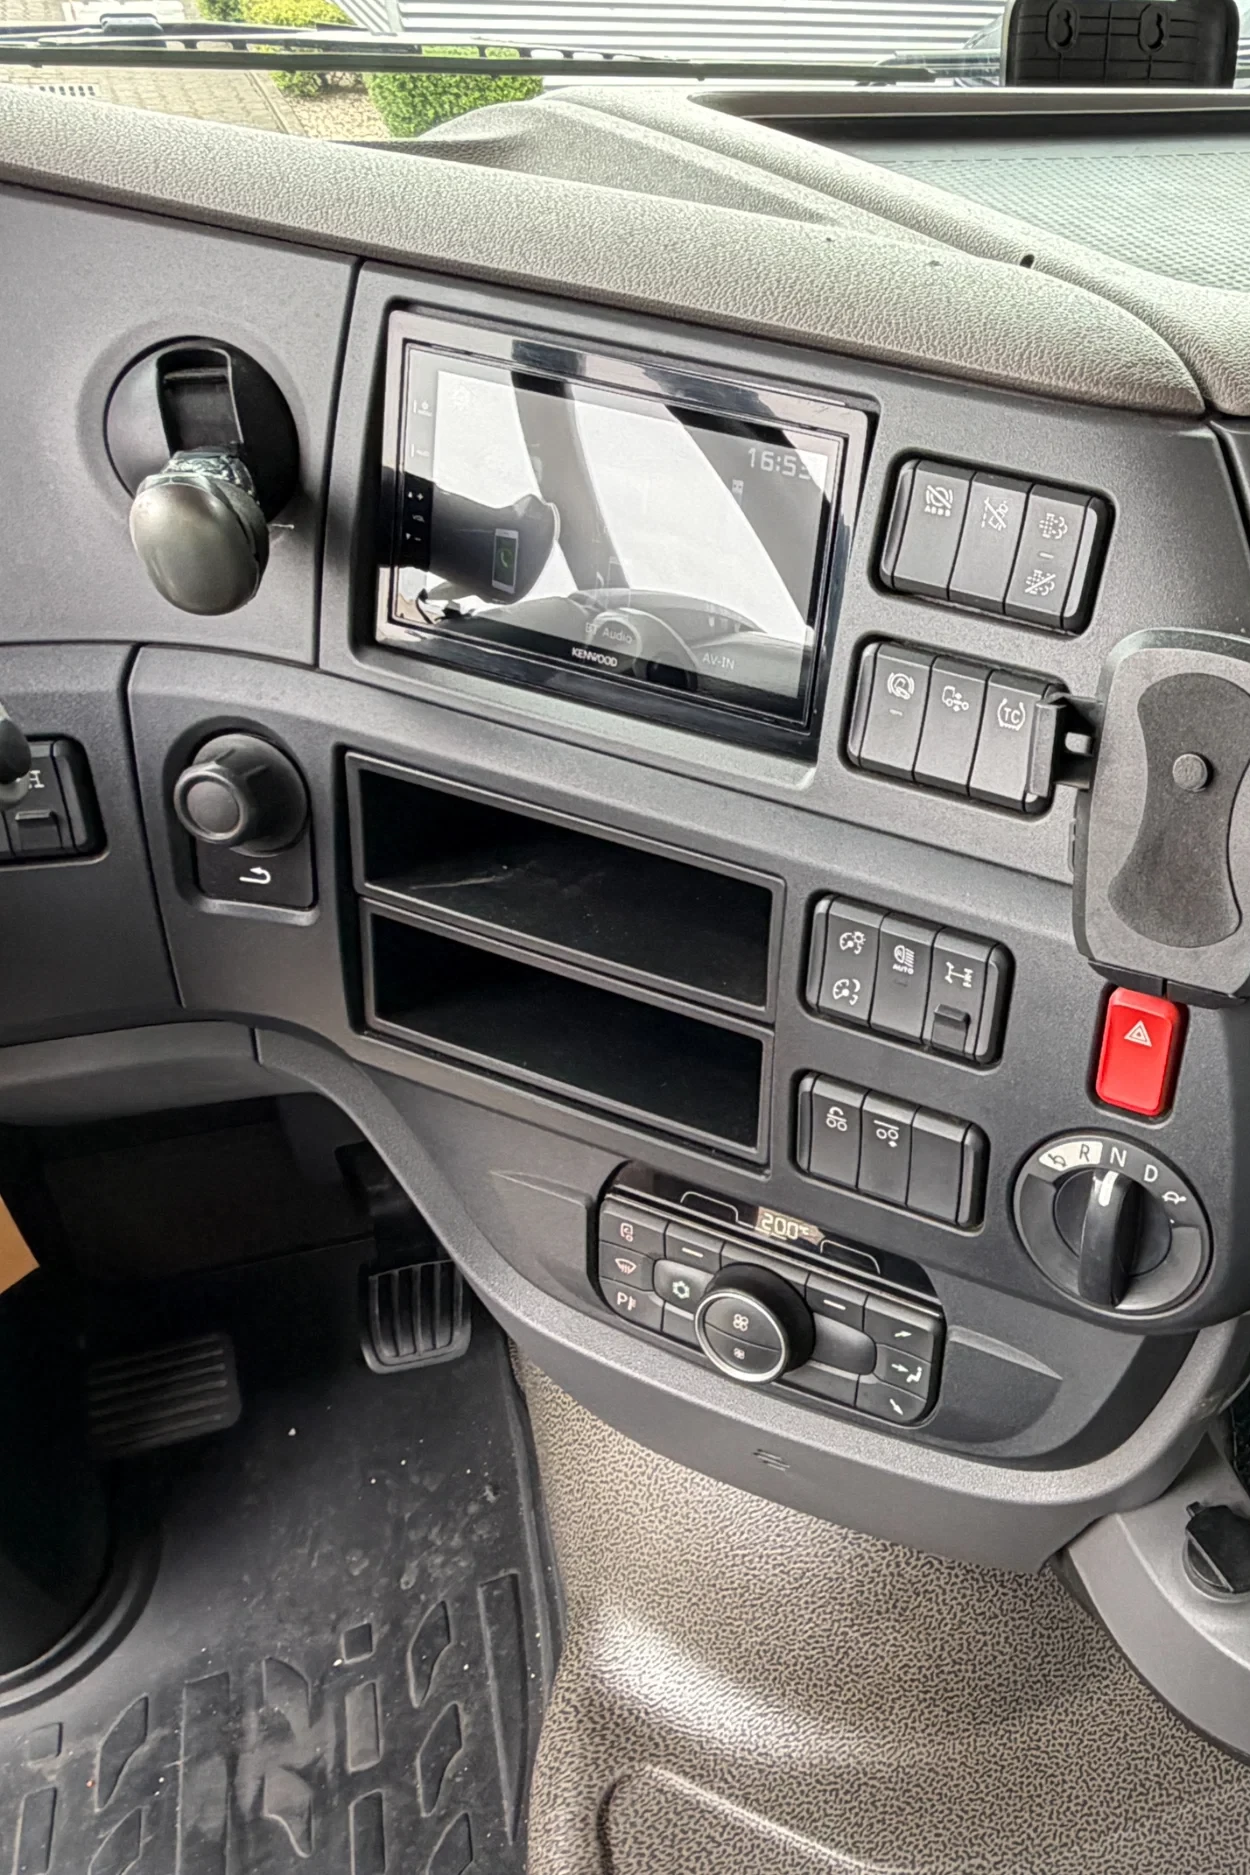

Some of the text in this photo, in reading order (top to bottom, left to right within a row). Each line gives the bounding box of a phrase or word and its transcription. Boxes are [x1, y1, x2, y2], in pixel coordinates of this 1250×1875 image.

[602, 627, 633, 645] Audio
[571, 647, 618, 668] KENWOOD
[702, 652, 736, 670] AV-IN
[1004, 707, 1021, 724] TC
[1079, 1143, 1158, 1183] R N D
